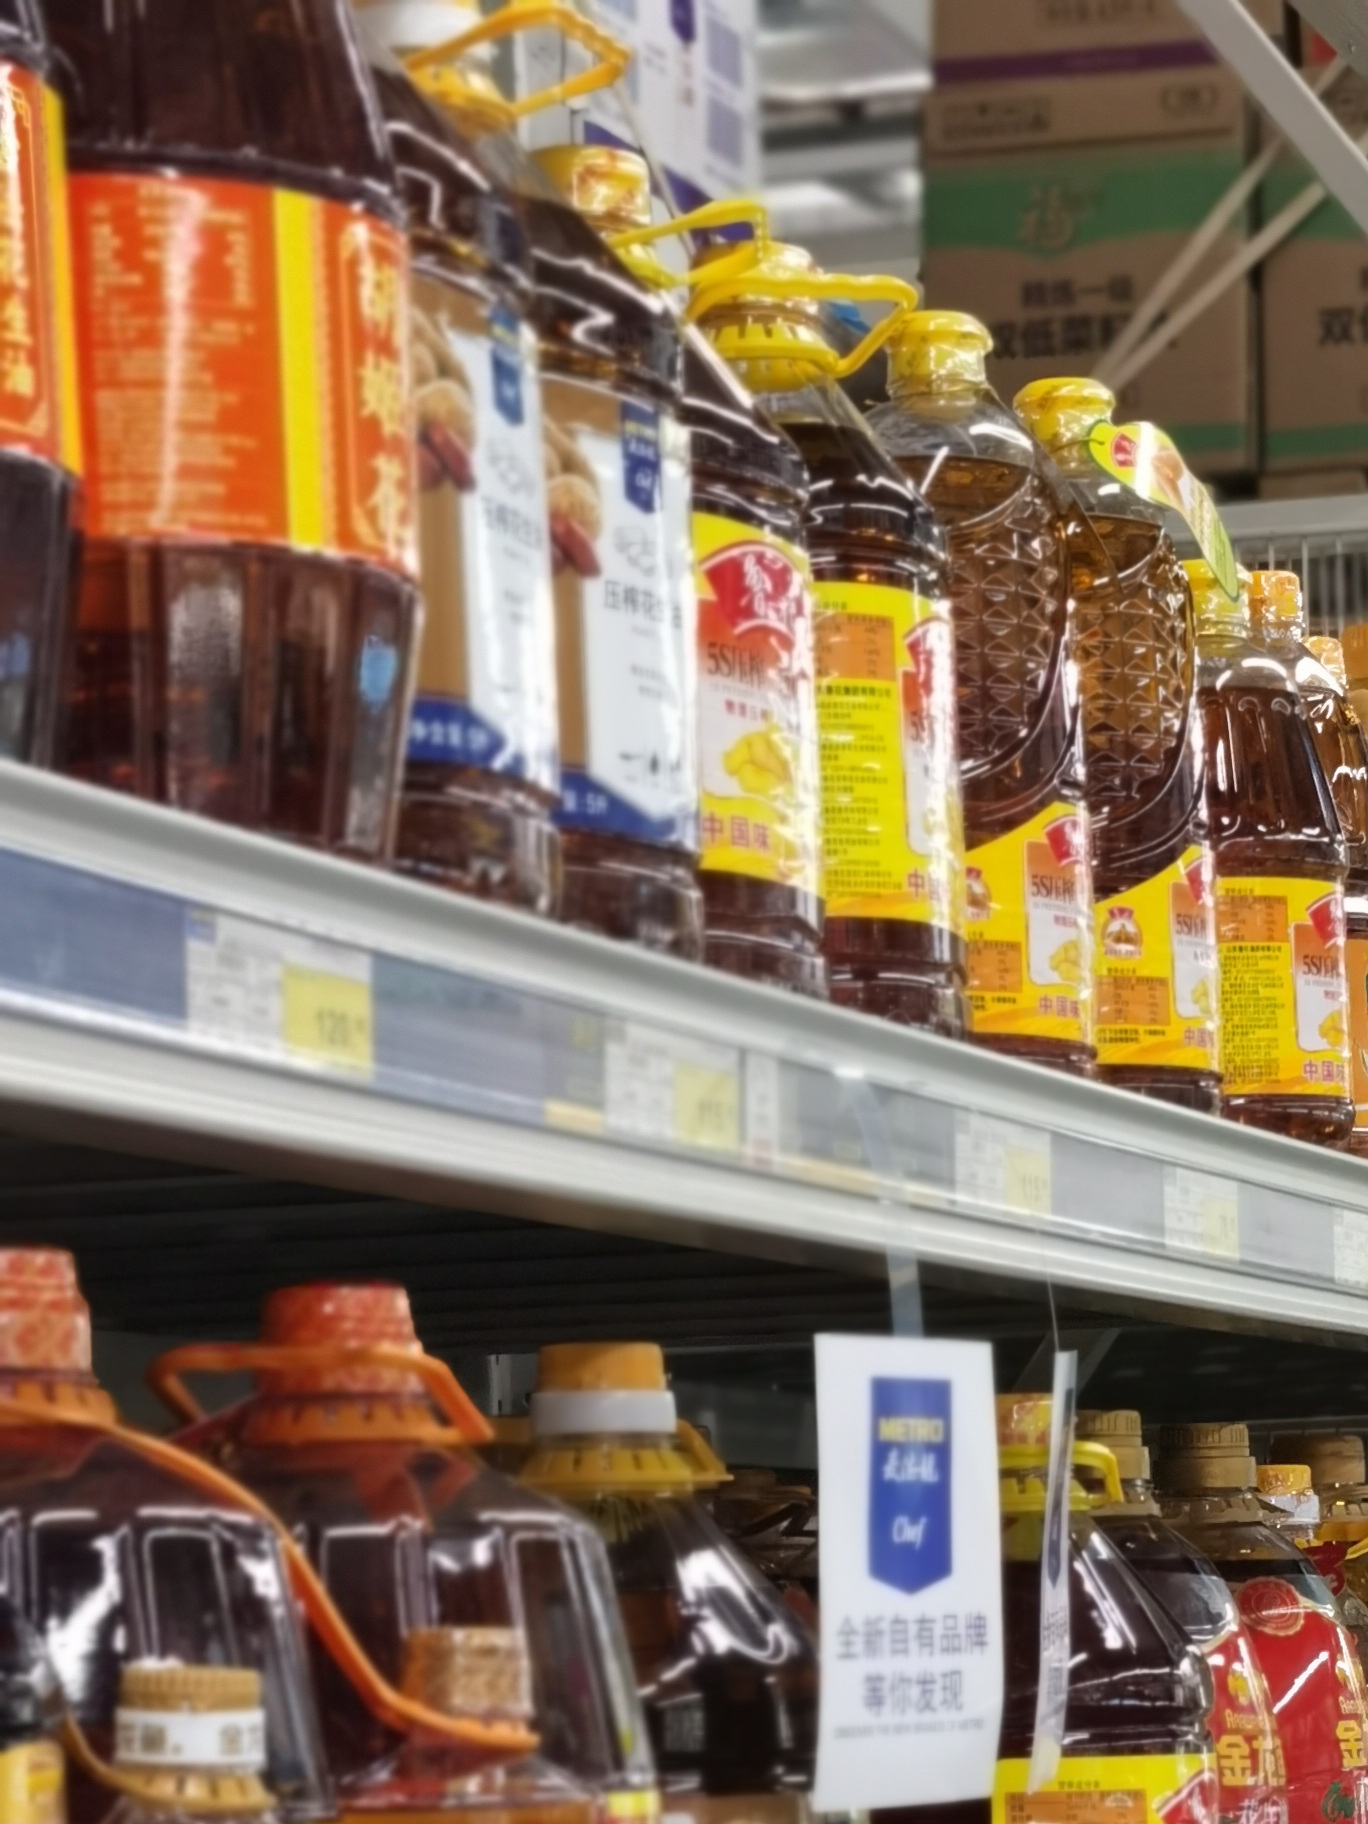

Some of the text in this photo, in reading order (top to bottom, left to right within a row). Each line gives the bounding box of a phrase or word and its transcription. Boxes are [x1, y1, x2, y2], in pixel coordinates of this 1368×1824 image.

[878, 1416, 945, 1445] METRO
[891, 1515, 927, 1551] Chef
[836, 1612, 989, 1662] 全新自有品牌
[863, 1669, 965, 1718] 等你发现
[1216, 1733, 1287, 1787] 金龙
